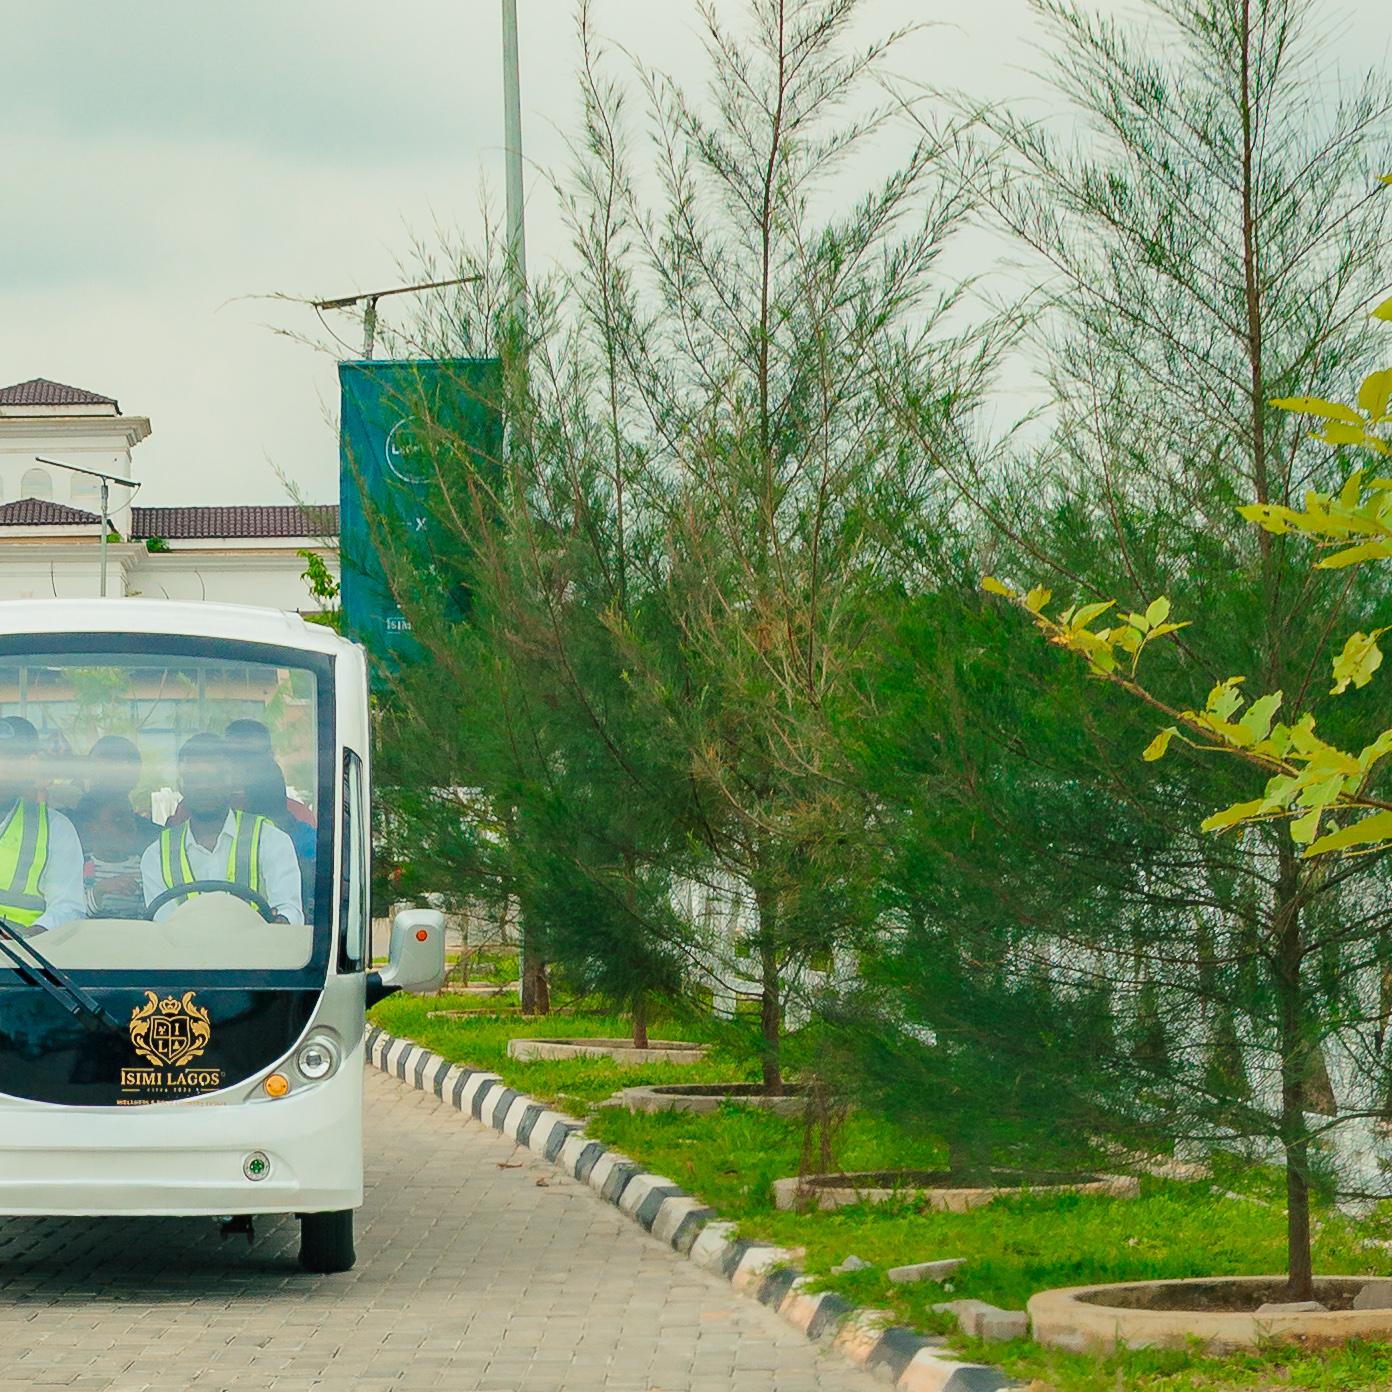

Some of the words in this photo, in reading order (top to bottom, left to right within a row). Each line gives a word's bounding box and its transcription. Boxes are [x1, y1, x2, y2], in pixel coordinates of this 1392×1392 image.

[174, 1023, 180, 1036] I
[158, 1040, 168, 1053] L
[166, 1072, 220, 1086] LAGOS
